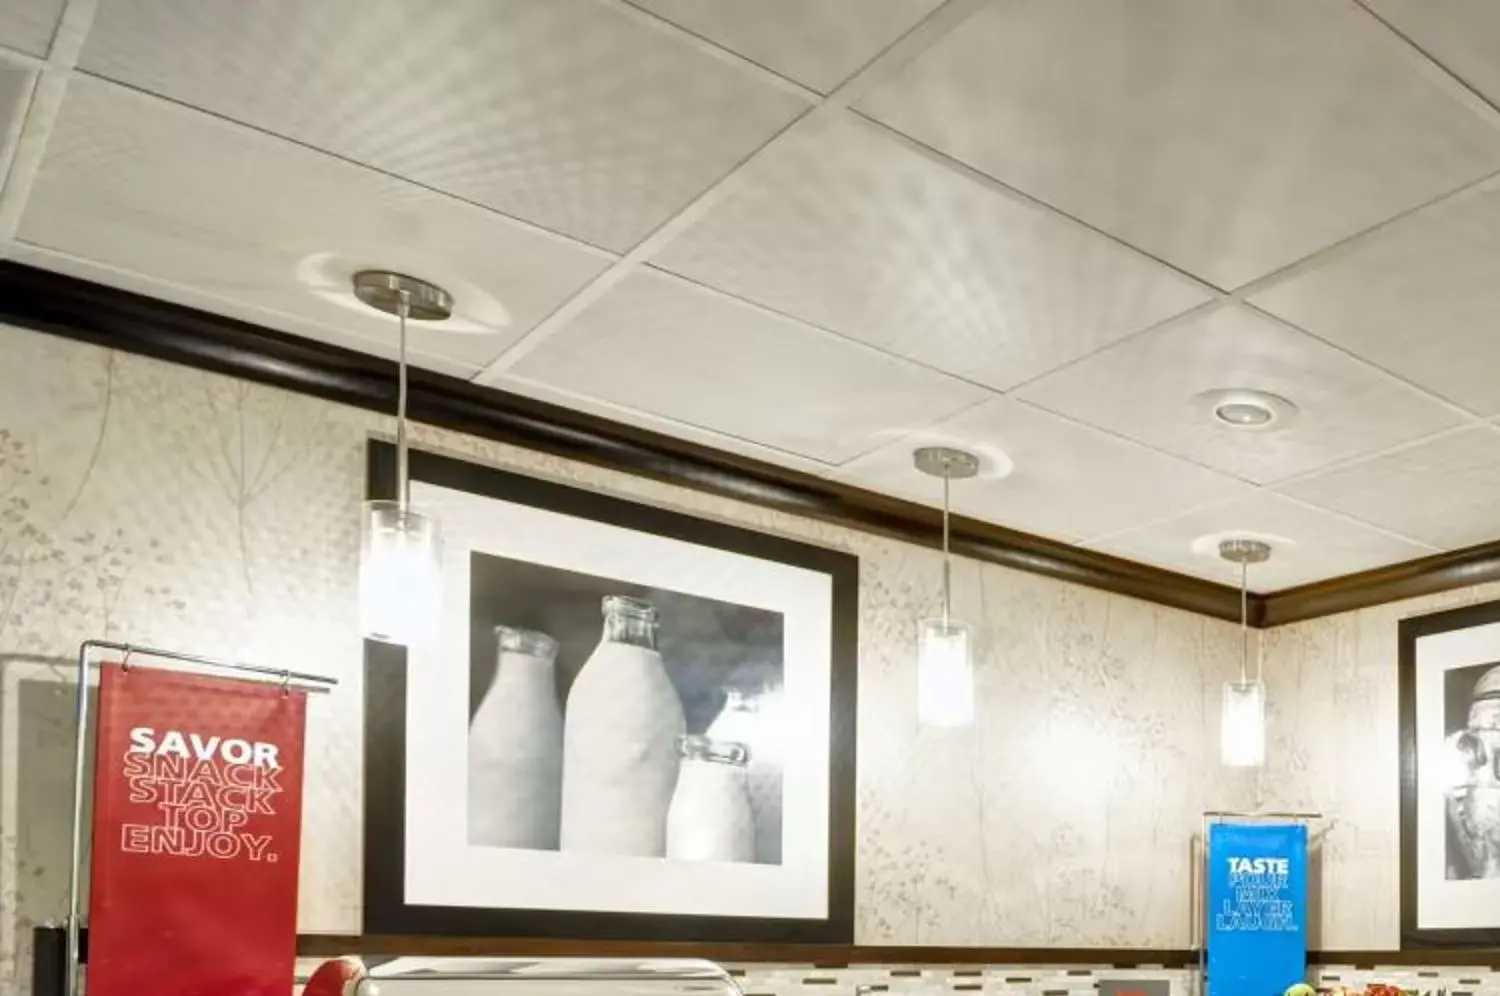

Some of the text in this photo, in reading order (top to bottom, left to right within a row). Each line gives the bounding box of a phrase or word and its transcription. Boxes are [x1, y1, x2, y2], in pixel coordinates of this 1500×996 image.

[129, 727, 279, 768] SAVOR
[123, 751, 284, 793] SNACK
[129, 775, 276, 815] STACK
[158, 801, 248, 834] TOP
[121, 823, 278, 862] ENJOY.
[1226, 857, 1289, 875] TASTE
